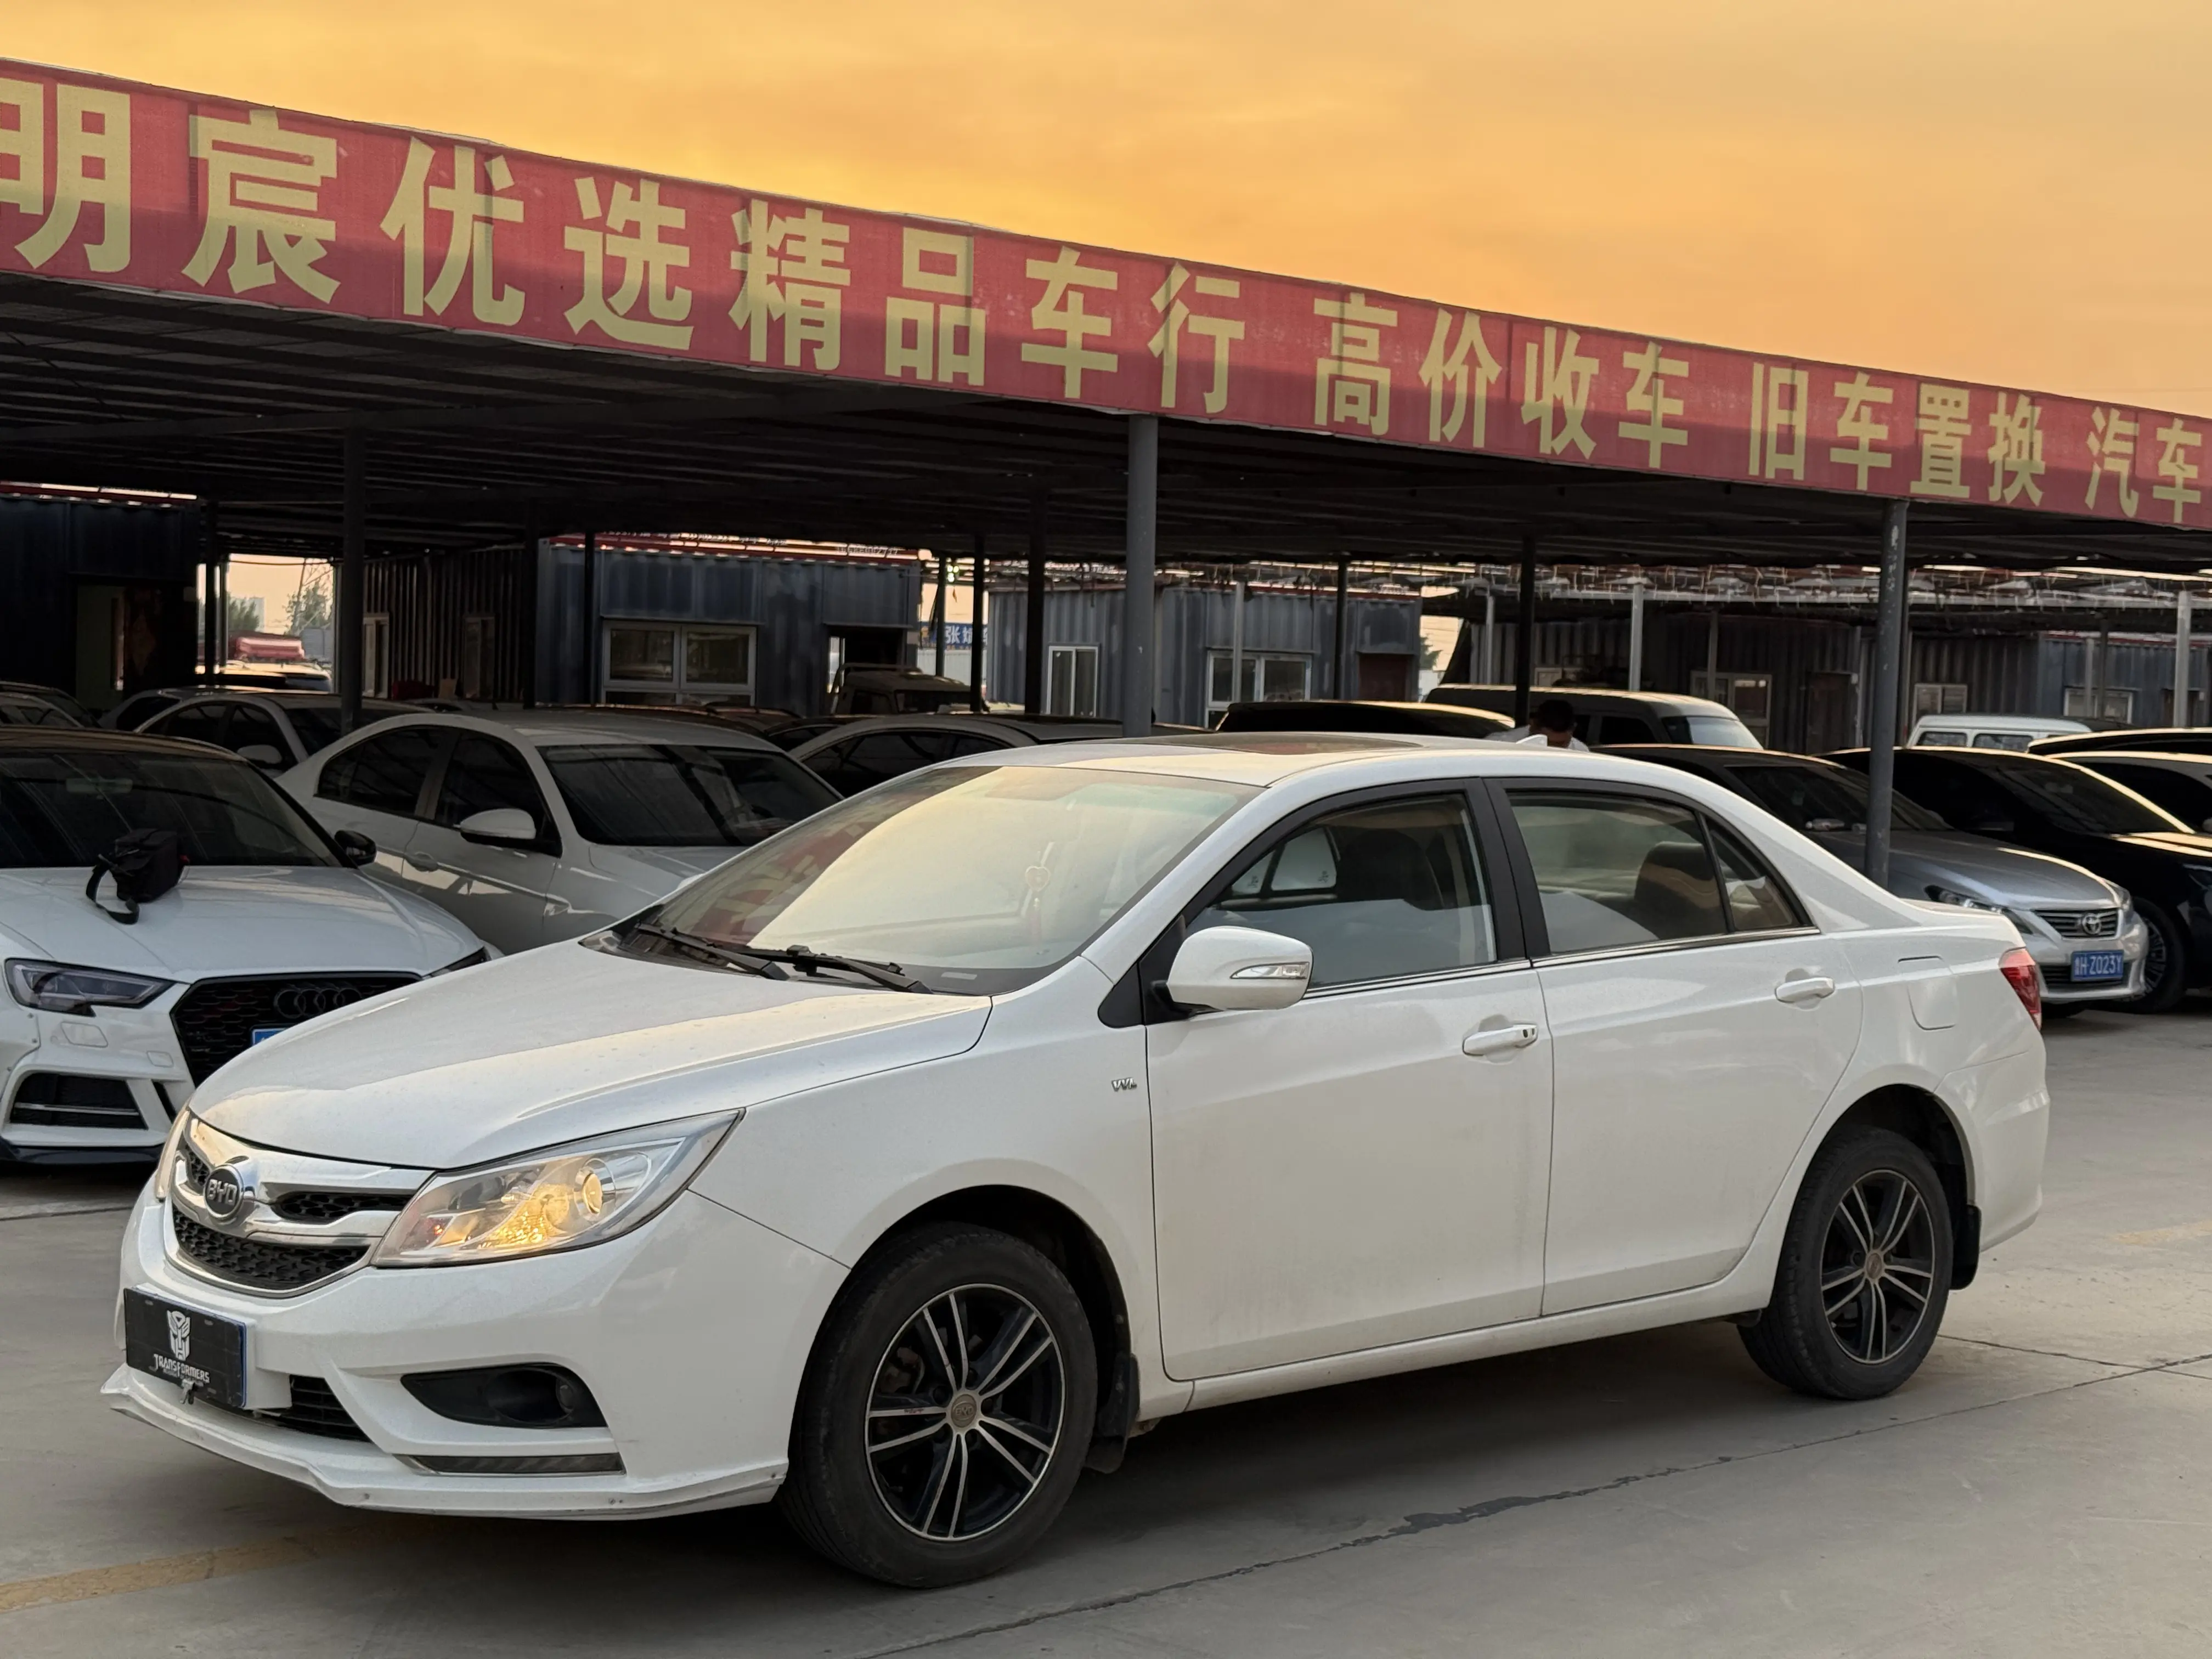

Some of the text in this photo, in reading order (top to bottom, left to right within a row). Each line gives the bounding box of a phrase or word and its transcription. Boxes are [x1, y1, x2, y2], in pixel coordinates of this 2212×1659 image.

[0, 76, 1244, 414] 明宸优选精品车行
[1314, 292, 1689, 469] 高价收车
[1748, 362, 2045, 506] 旧车置换
[2085, 406, 2202, 523] 汽车
[207, 1179, 238, 1206] BYD
[149, 1353, 210, 1383] TRANSFORMERS
[955, 1406, 974, 1416] BYD
